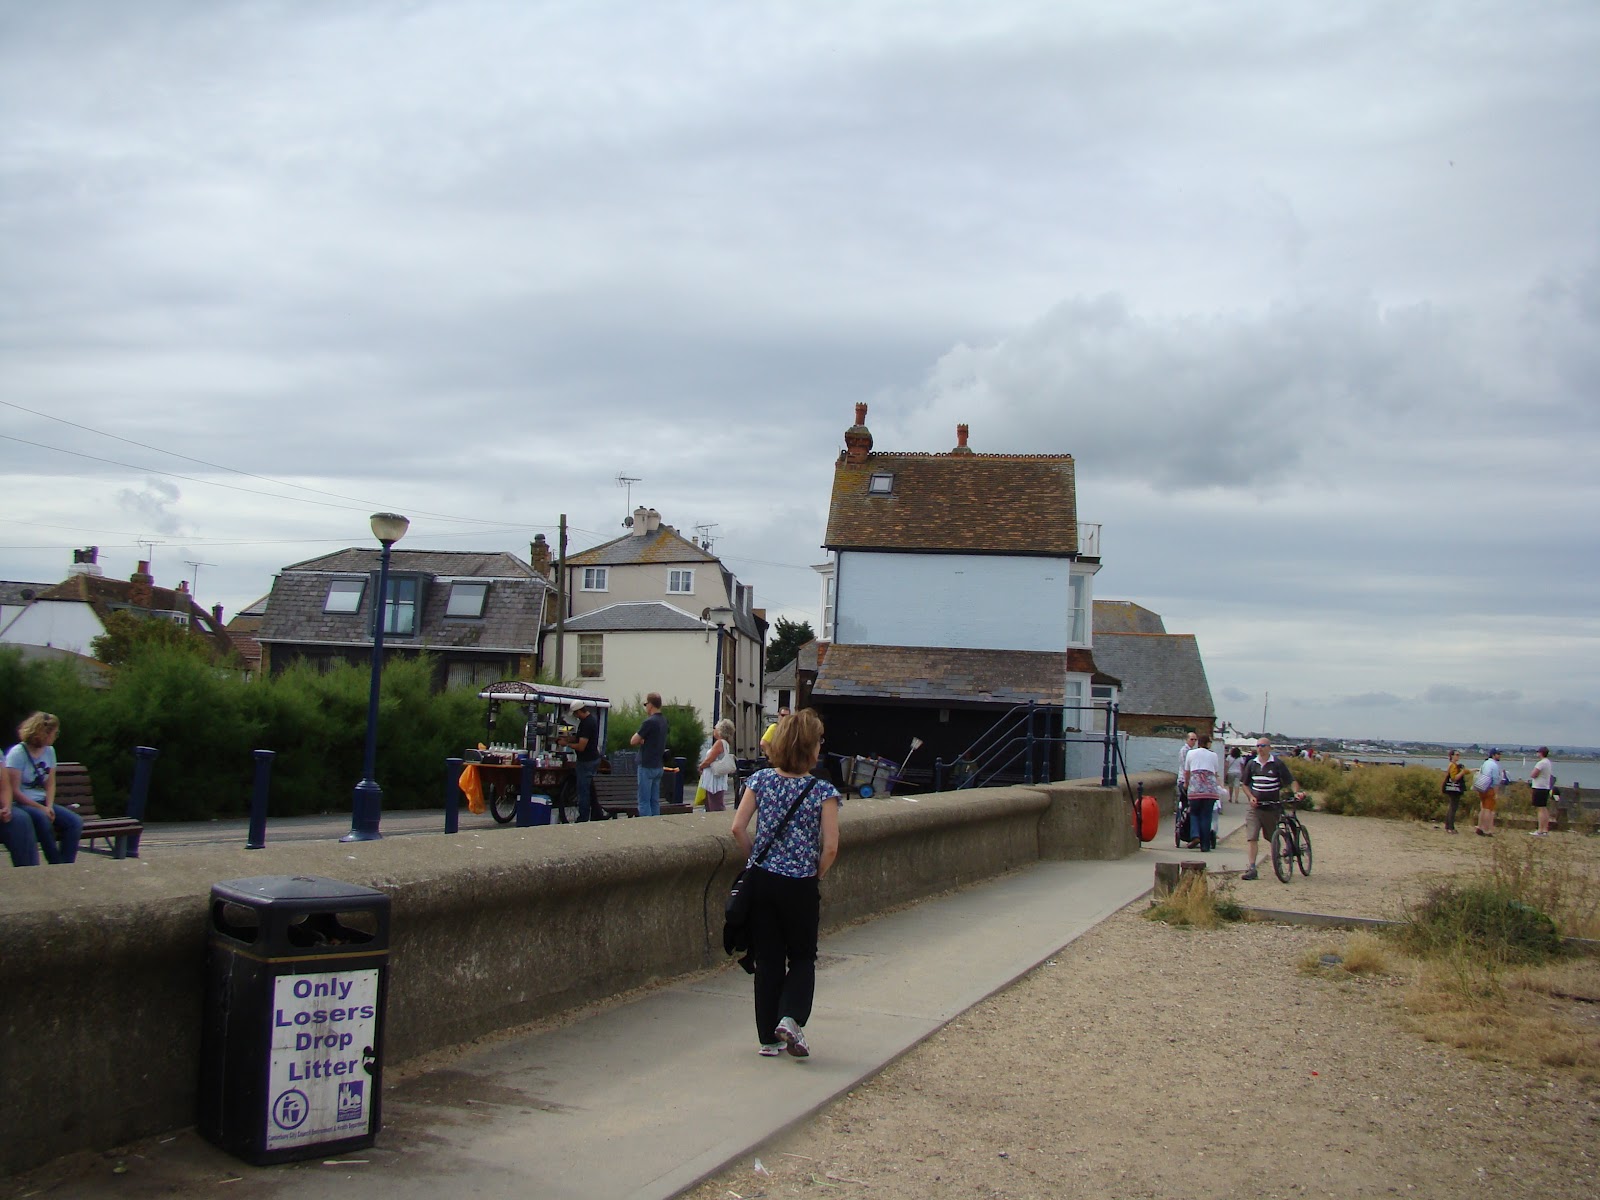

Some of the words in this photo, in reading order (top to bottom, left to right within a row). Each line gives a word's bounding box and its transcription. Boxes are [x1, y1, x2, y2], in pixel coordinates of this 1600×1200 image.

[293, 977, 353, 1000] Only
[275, 1005, 374, 1027] Losers
[296, 1032, 353, 1051] Drop
[289, 1058, 358, 1081] Litter
